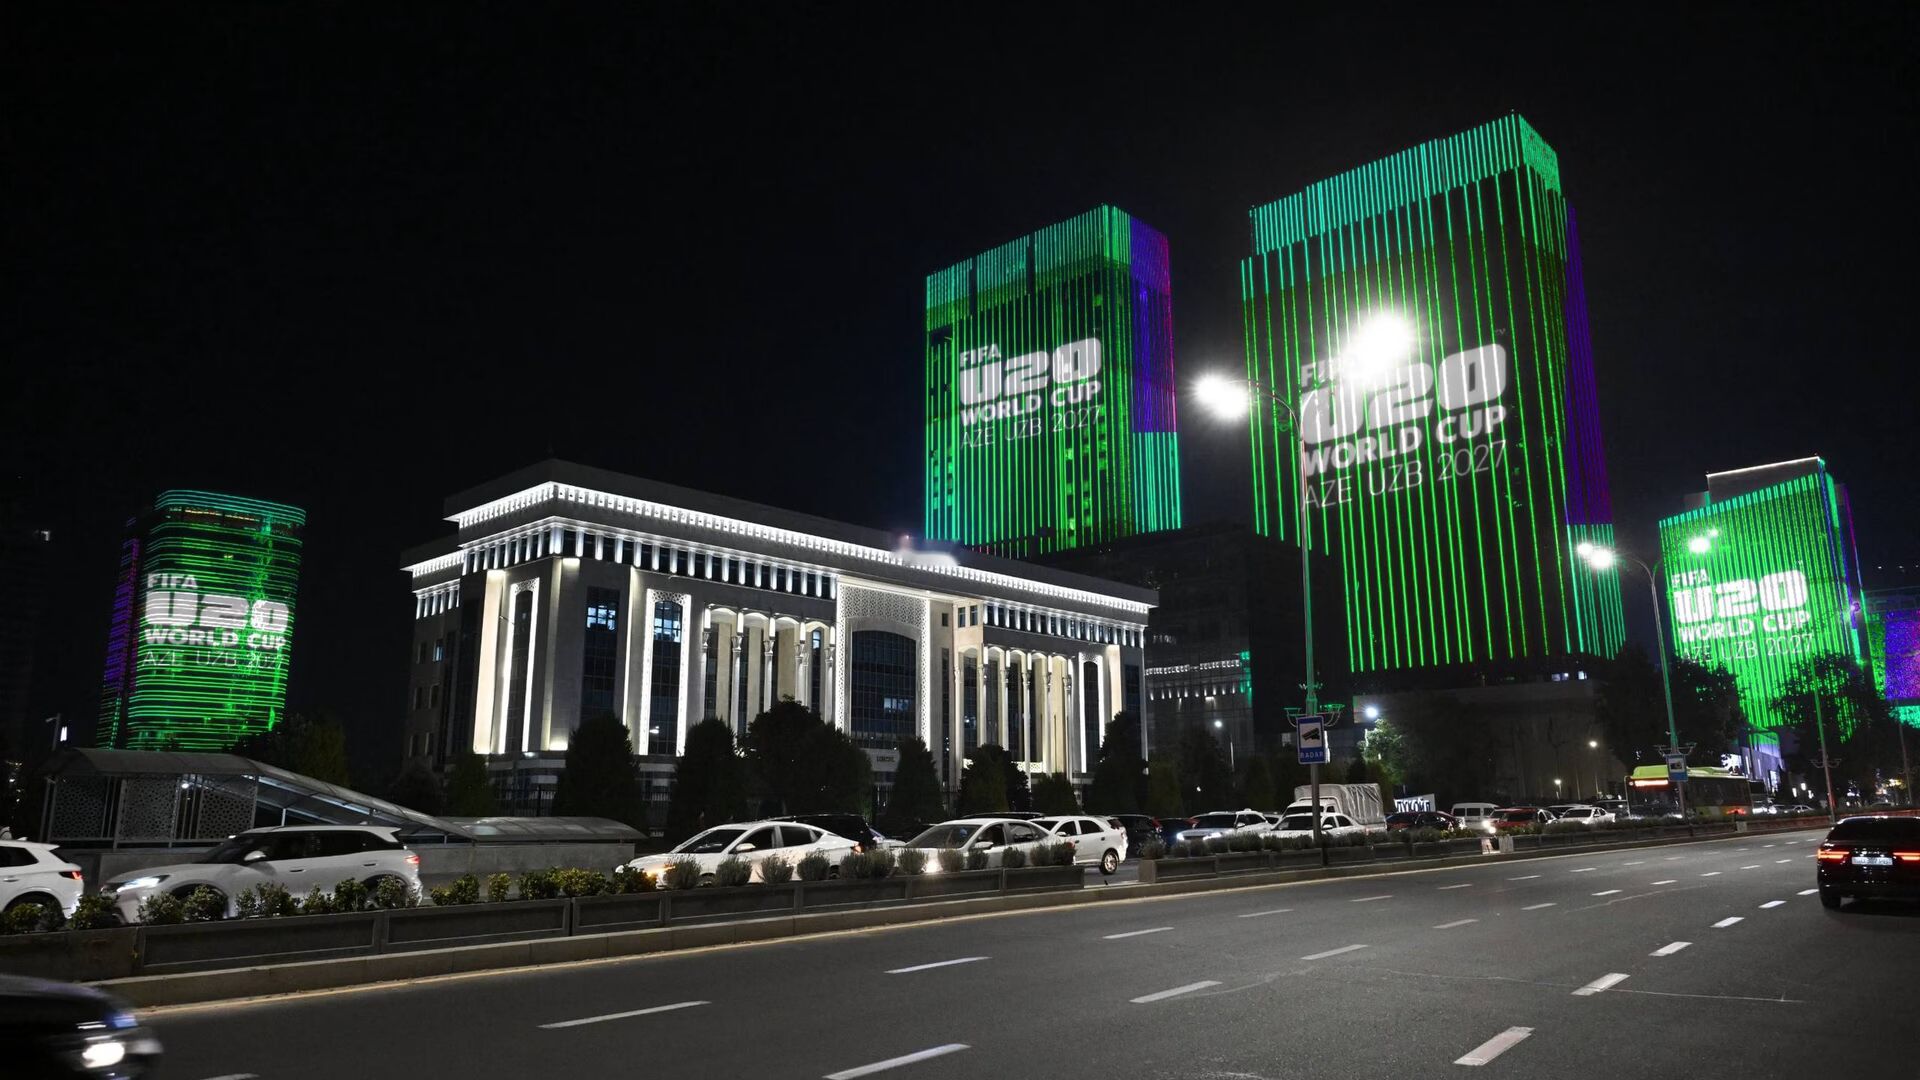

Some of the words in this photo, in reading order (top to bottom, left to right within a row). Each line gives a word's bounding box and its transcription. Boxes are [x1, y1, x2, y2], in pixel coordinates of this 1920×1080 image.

[960, 343, 1001, 367] FIFA
[960, 337, 1101, 406] U20
[960, 394, 1042, 426] WORLD
[1051, 380, 1102, 407] CUP
[1300, 343, 1507, 444] U20
[960, 426, 995, 449] AZE
[1004, 417, 1042, 441] UZB
[1051, 404, 1101, 432] 2027
[1303, 426, 1422, 477] WORLD
[1436, 405, 1507, 444] CUP
[1305, 475, 1353, 509] AZE
[1369, 459, 1423, 496] UZB
[1437, 440, 1506, 482] 2027
[148, 573, 198, 590] FIFA
[1671, 568, 1710, 588] FIFA
[1673, 569, 1808, 624] U20
[145, 591, 289, 633] U20
[1679, 618, 1754, 643] WORLD
[1763, 610, 1811, 632] CUP
[144, 628, 239, 647] WORLD
[247, 632, 287, 649] CUP
[1682, 645, 1713, 664] AZE
[1721, 639, 1757, 660] UZB
[1766, 633, 1813, 656] 2027
[142, 649, 184, 667] AZE
[196, 650, 237, 667] UZB
[1300, 751, 1323, 760] RADAR
